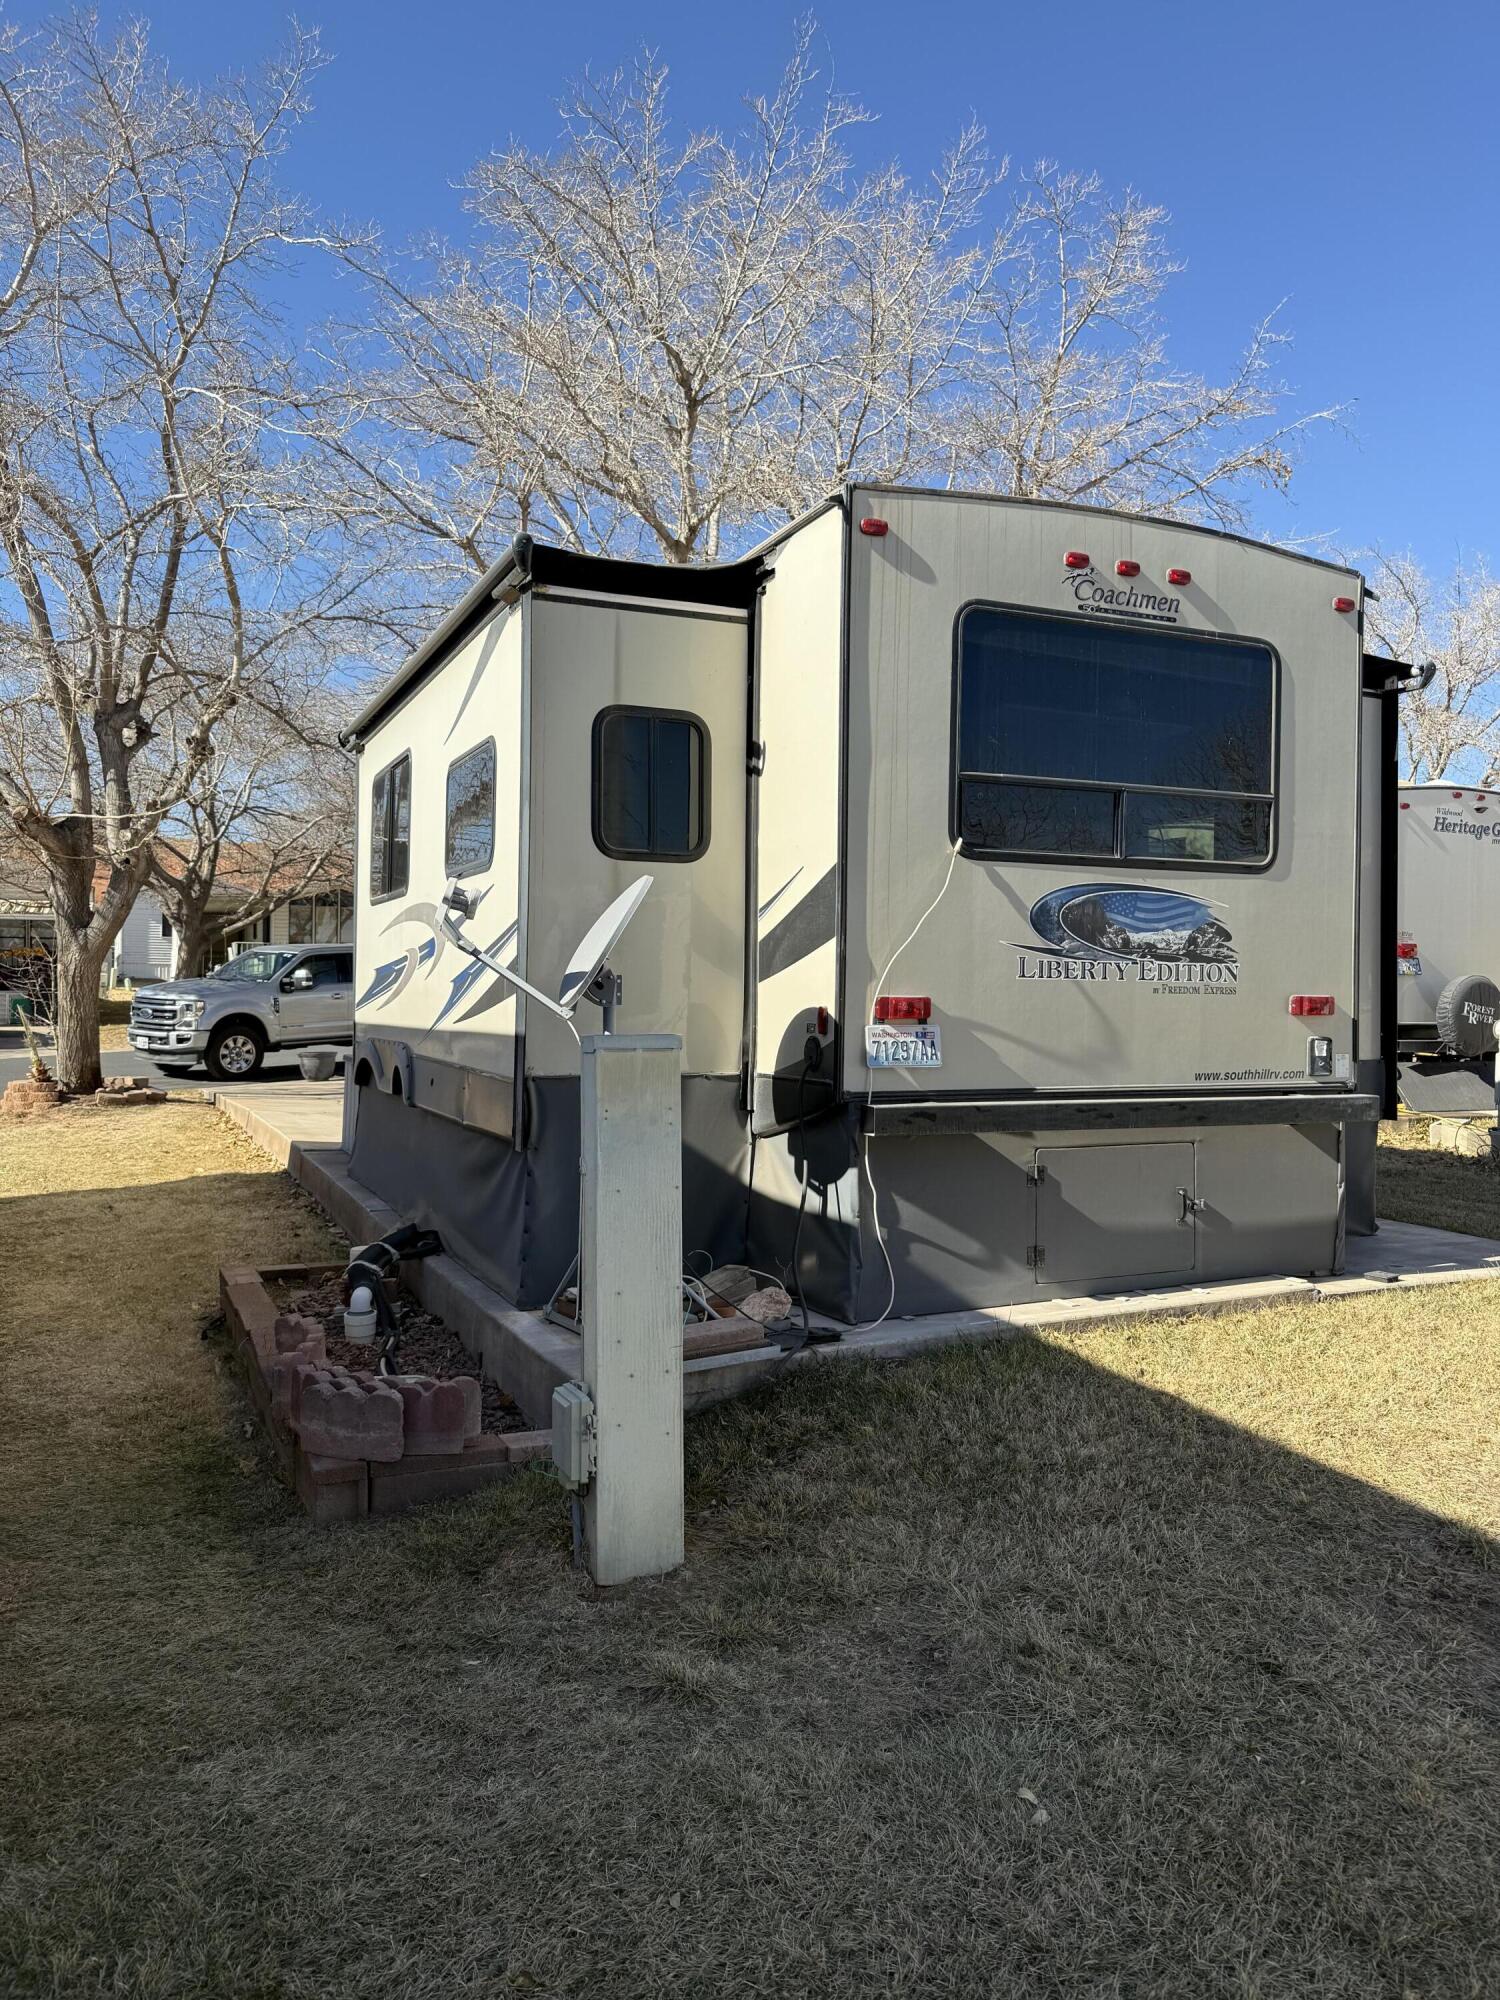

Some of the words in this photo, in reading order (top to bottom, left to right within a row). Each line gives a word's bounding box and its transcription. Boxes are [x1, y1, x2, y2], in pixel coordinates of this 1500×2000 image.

[1074, 580, 1181, 613] Coachmen
[1436, 807, 1464, 816] Wildwood
[1433, 816, 1490, 840] Heritage
[1017, 956, 1131, 982] LIBERTY
[1137, 958, 1239, 983] EDITION
[1162, 984, 1201, 995] FREEDOM
[1203, 984, 1237, 995] EXPRESS
[1461, 1001, 1495, 1016] FOREST
[1468, 1010, 1494, 1025] RIVER
[872, 1031, 913, 1039] WASHINGTON
[872, 1039, 938, 1061] 71297AA
[1194, 1068, 1305, 1081] www.southhillrv.com
